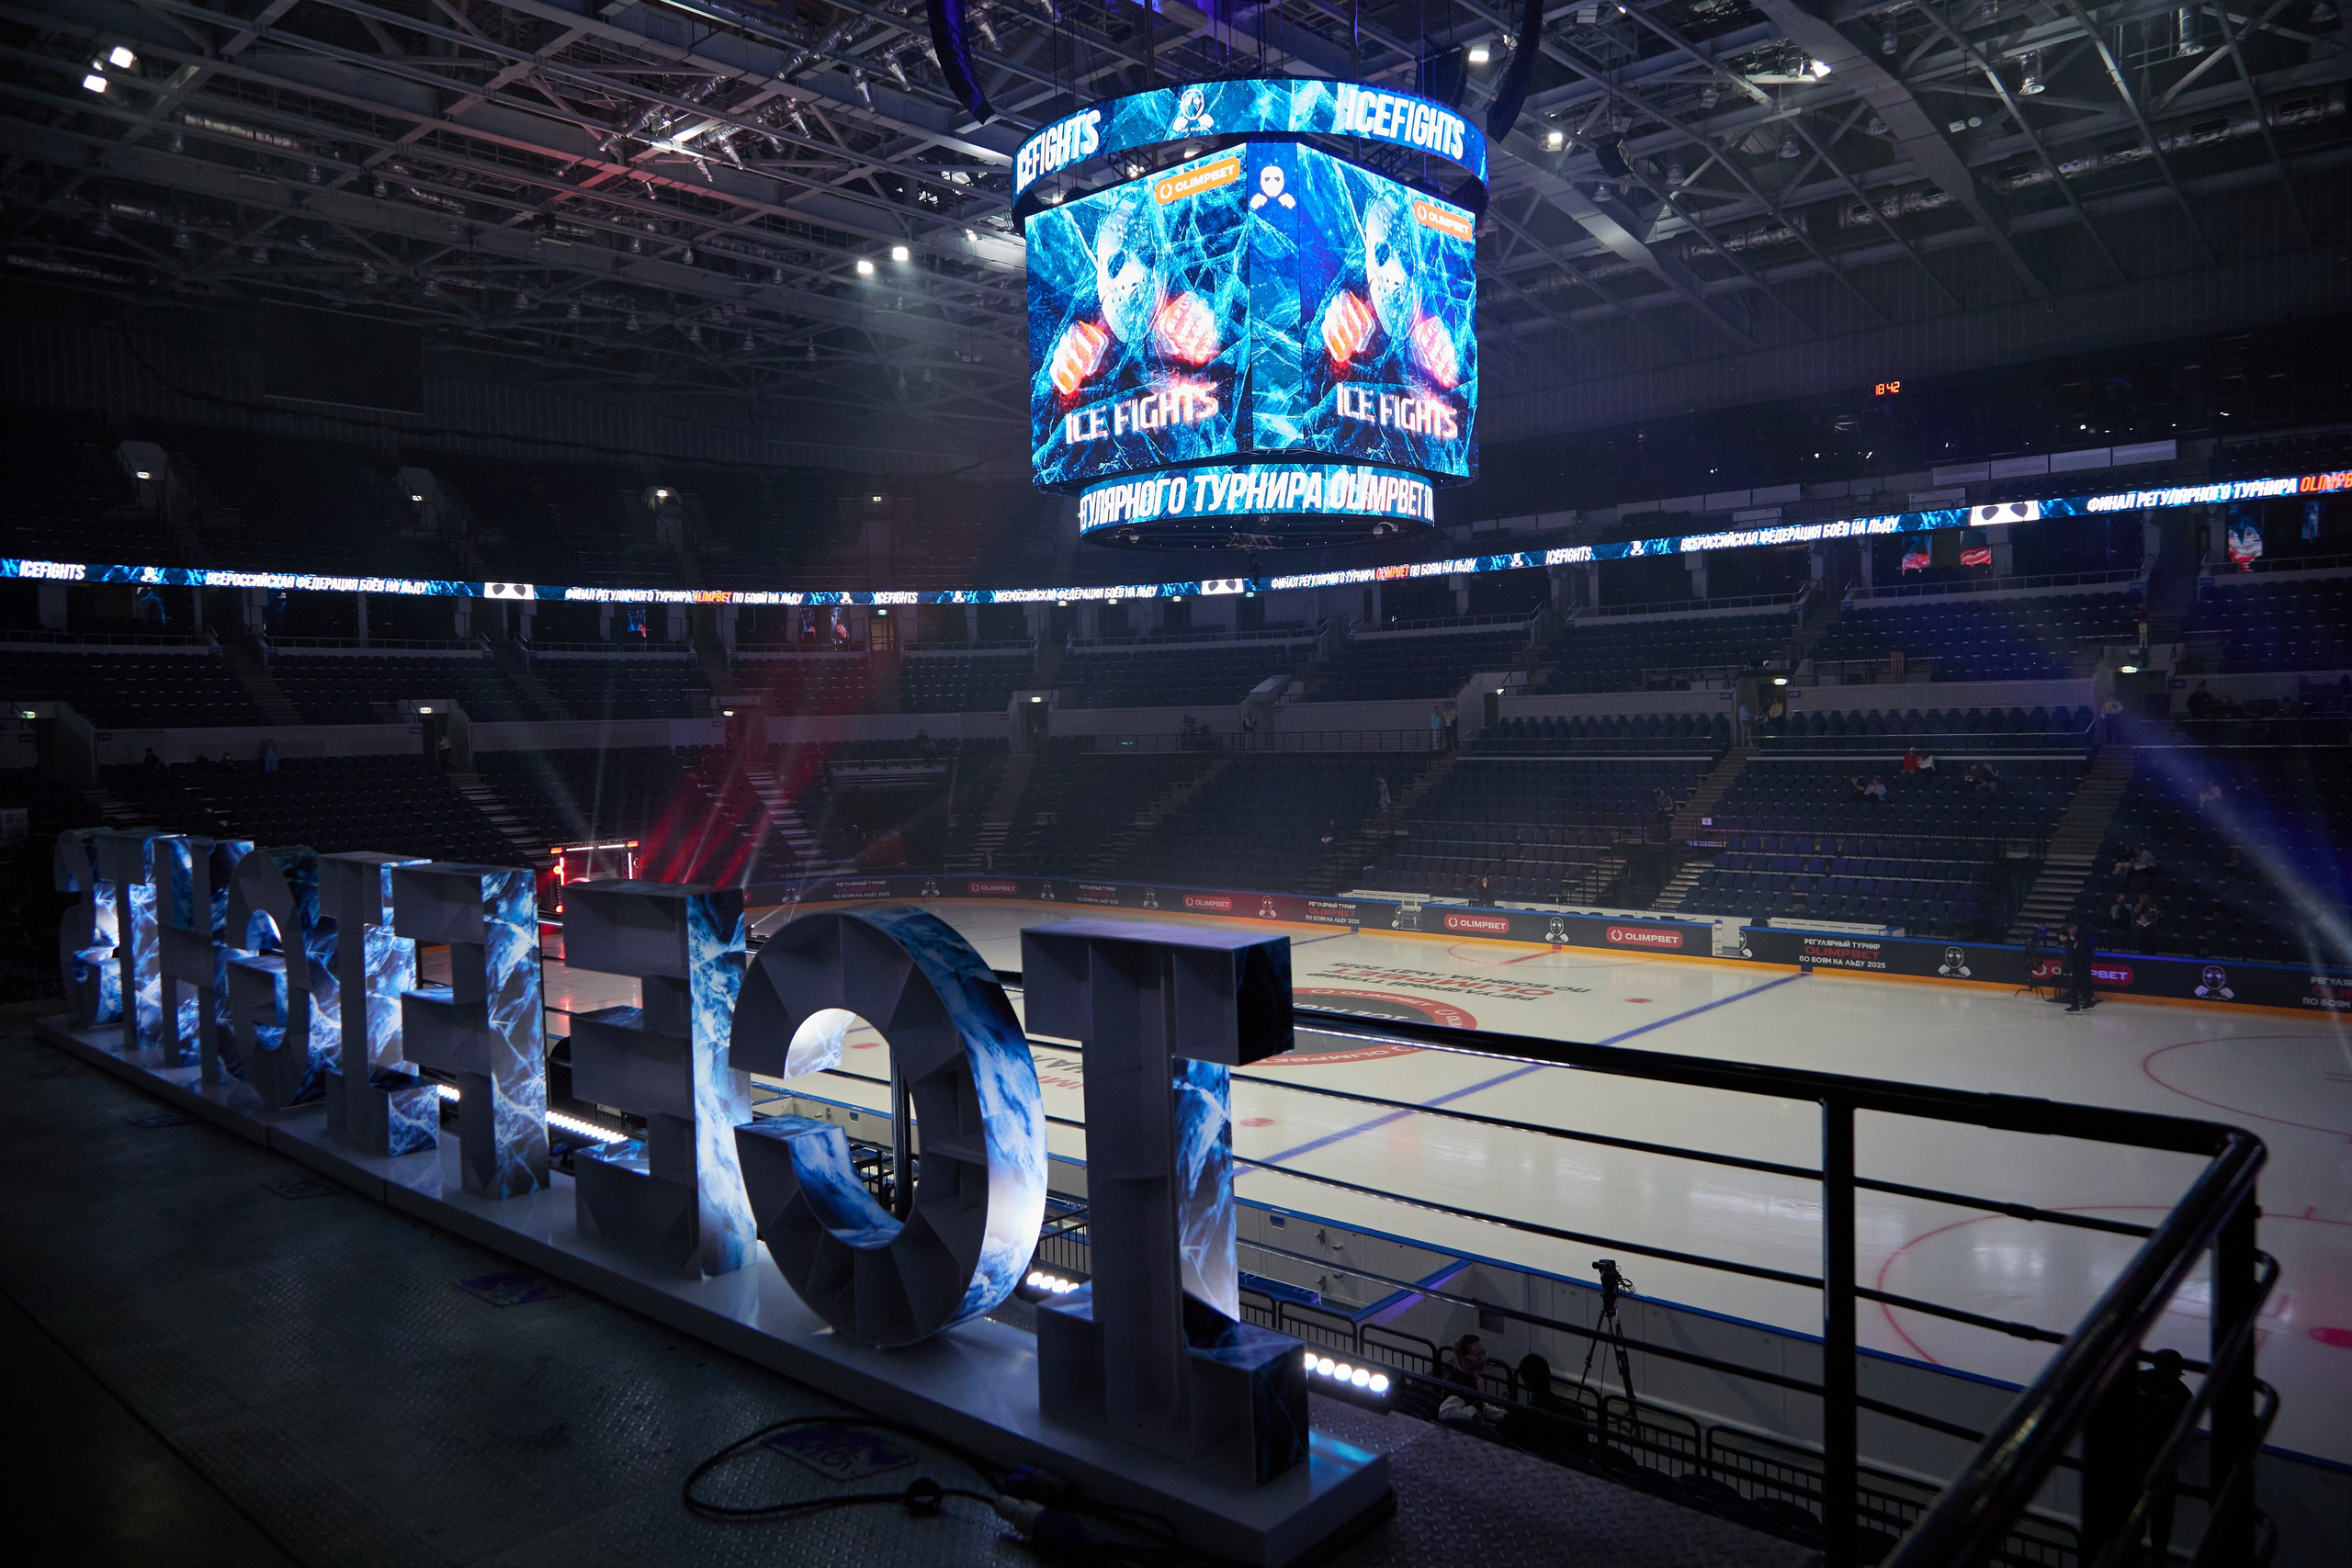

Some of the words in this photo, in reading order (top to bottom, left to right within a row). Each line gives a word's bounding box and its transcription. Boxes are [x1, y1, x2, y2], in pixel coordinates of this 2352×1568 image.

[1345, 90, 1465, 160] ICEFIGHTS
[1174, 164, 1236, 193] OLIMPBET
[1428, 211, 1469, 235] OLIMPBET
[1066, 405, 1109, 445] ICE
[1114, 382, 1219, 435] FIGHTS
[1337, 382, 1376, 423] ICE
[1380, 389, 1458, 438] FIGHTS
[1193, 471, 1323, 513] ТУРНИРА
[1329, 471, 1424, 517] OLIMPBET
[2086, 493, 2135, 513] ФИНАЛ
[2136, 485, 2231, 508] РЕГУЛЯРНОГО
[2233, 478, 2298, 499] ТУРНИРА
[1680, 530, 1758, 551] ВСЕРОССИЙСКАЯ
[1759, 525, 1822, 544] ФЕДЕРАЦИЯ
[1823, 519, 1850, 538] БОЁВ
[1850, 520, 1866, 536] НА
[1867, 516, 1900, 535] ЛЬДУ
[1545, 547, 1592, 564] ICEFIGHTS
[19, 559, 86, 581] ICEFIGHTS
[1271, 576, 1299, 589] ФИНАЛ
[1299, 573, 1345, 587] РЕГУЛЯРНОГО
[1346, 570, 1375, 583] ТУРНИРА
[1376, 566, 1409, 581] OLIMPBET
[1410, 565, 1420, 577] ПО
[1421, 562, 1442, 575] БОЯМ
[1442, 561, 1453, 572] НА
[1453, 558, 1476, 573] ЛЬДУ
[205, 571, 295, 590] ВСЕРОССИЙСКАЯ
[296, 576, 358, 592] ФЕДЕРАЦИЯ
[358, 577, 385, 592] БОЁВ
[385, 580, 400, 593] НА
[400, 581, 428, 596] ЛЬДУ
[874, 591, 918, 604] ICEFIGHTS
[994, 589, 1057, 603] ВСЕРОССИЙСКАЯ
[1057, 588, 1103, 600] ФЕДЕРАЦИЯ
[1104, 585, 1124, 598] БОЁВ
[1125, 586, 1136, 597] НА
[1136, 585, 1158, 598] ЛЬДУ
[980, 884, 1016, 892] OLIMPBET
[1194, 898, 1230, 908] OLIMPBET
[1308, 908, 1356, 917] OLIMPBET
[1459, 919, 1506, 931] OLIMPBET
[1624, 931, 1679, 945] OLIMPBET
[1804, 938, 1850, 948] РЕГУЛЯРНЫЙ
[1852, 942, 1881, 950] ТУРНИР
[1804, 945, 1881, 960] OLIMPBET
[1811, 956, 1832, 964] БОЯМ
[1833, 957, 1844, 965] НА
[1845, 959, 1866, 967] ЛЬДУ
[1867, 961, 1886, 969] 2025
[1306, 972, 1385, 985] ТУРНИР
[1321, 968, 1555, 996] OLIMPBET
[1340, 990, 1435, 1007] OLIMPBET
[1386, 981, 1539, 1001] РЕГУЛЯРНЫЙ
[2302, 997, 2319, 1006] ПО
[2320, 998, 2351, 1009] БОЯМ
[1258, 1049, 1390, 1064] OLIMPBET
